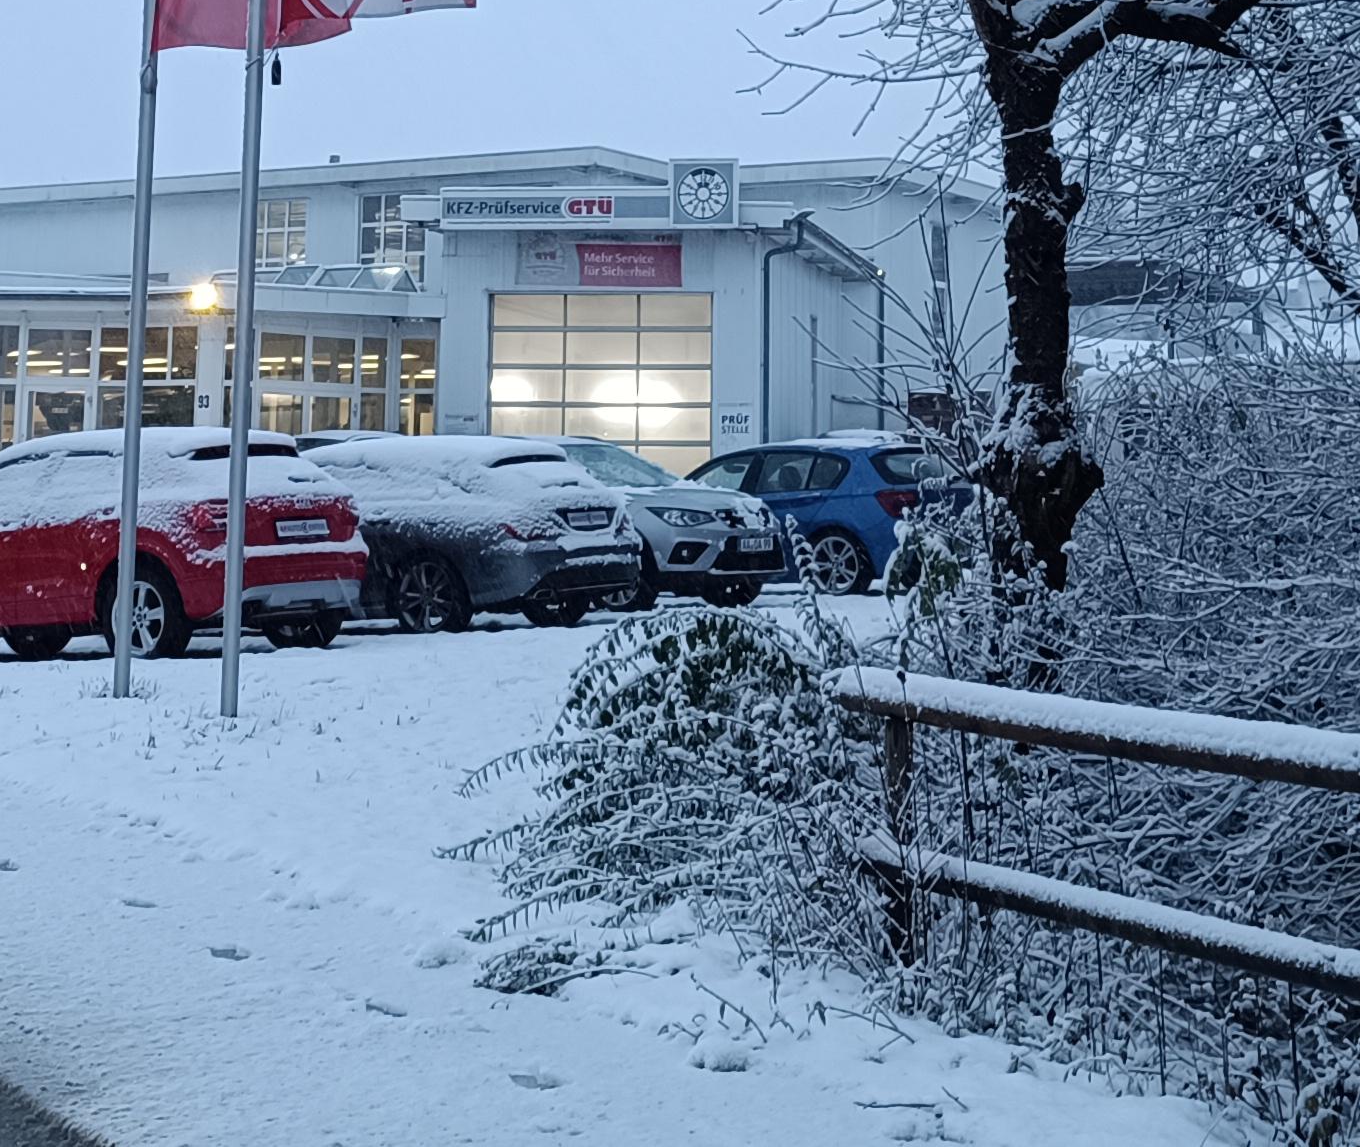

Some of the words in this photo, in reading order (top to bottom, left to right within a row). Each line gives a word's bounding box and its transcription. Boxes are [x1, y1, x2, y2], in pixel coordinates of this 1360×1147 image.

[446, 200, 561, 215] KFZ-Prüfservice
[567, 196, 613, 215] GTÜ
[584, 253, 613, 263] Mehr
[615, 253, 655, 264] Service
[584, 265, 601, 276] für
[602, 265, 656, 277] Sicherheit
[721, 413, 751, 424] PRÜF
[721, 425, 750, 434] STELLE
